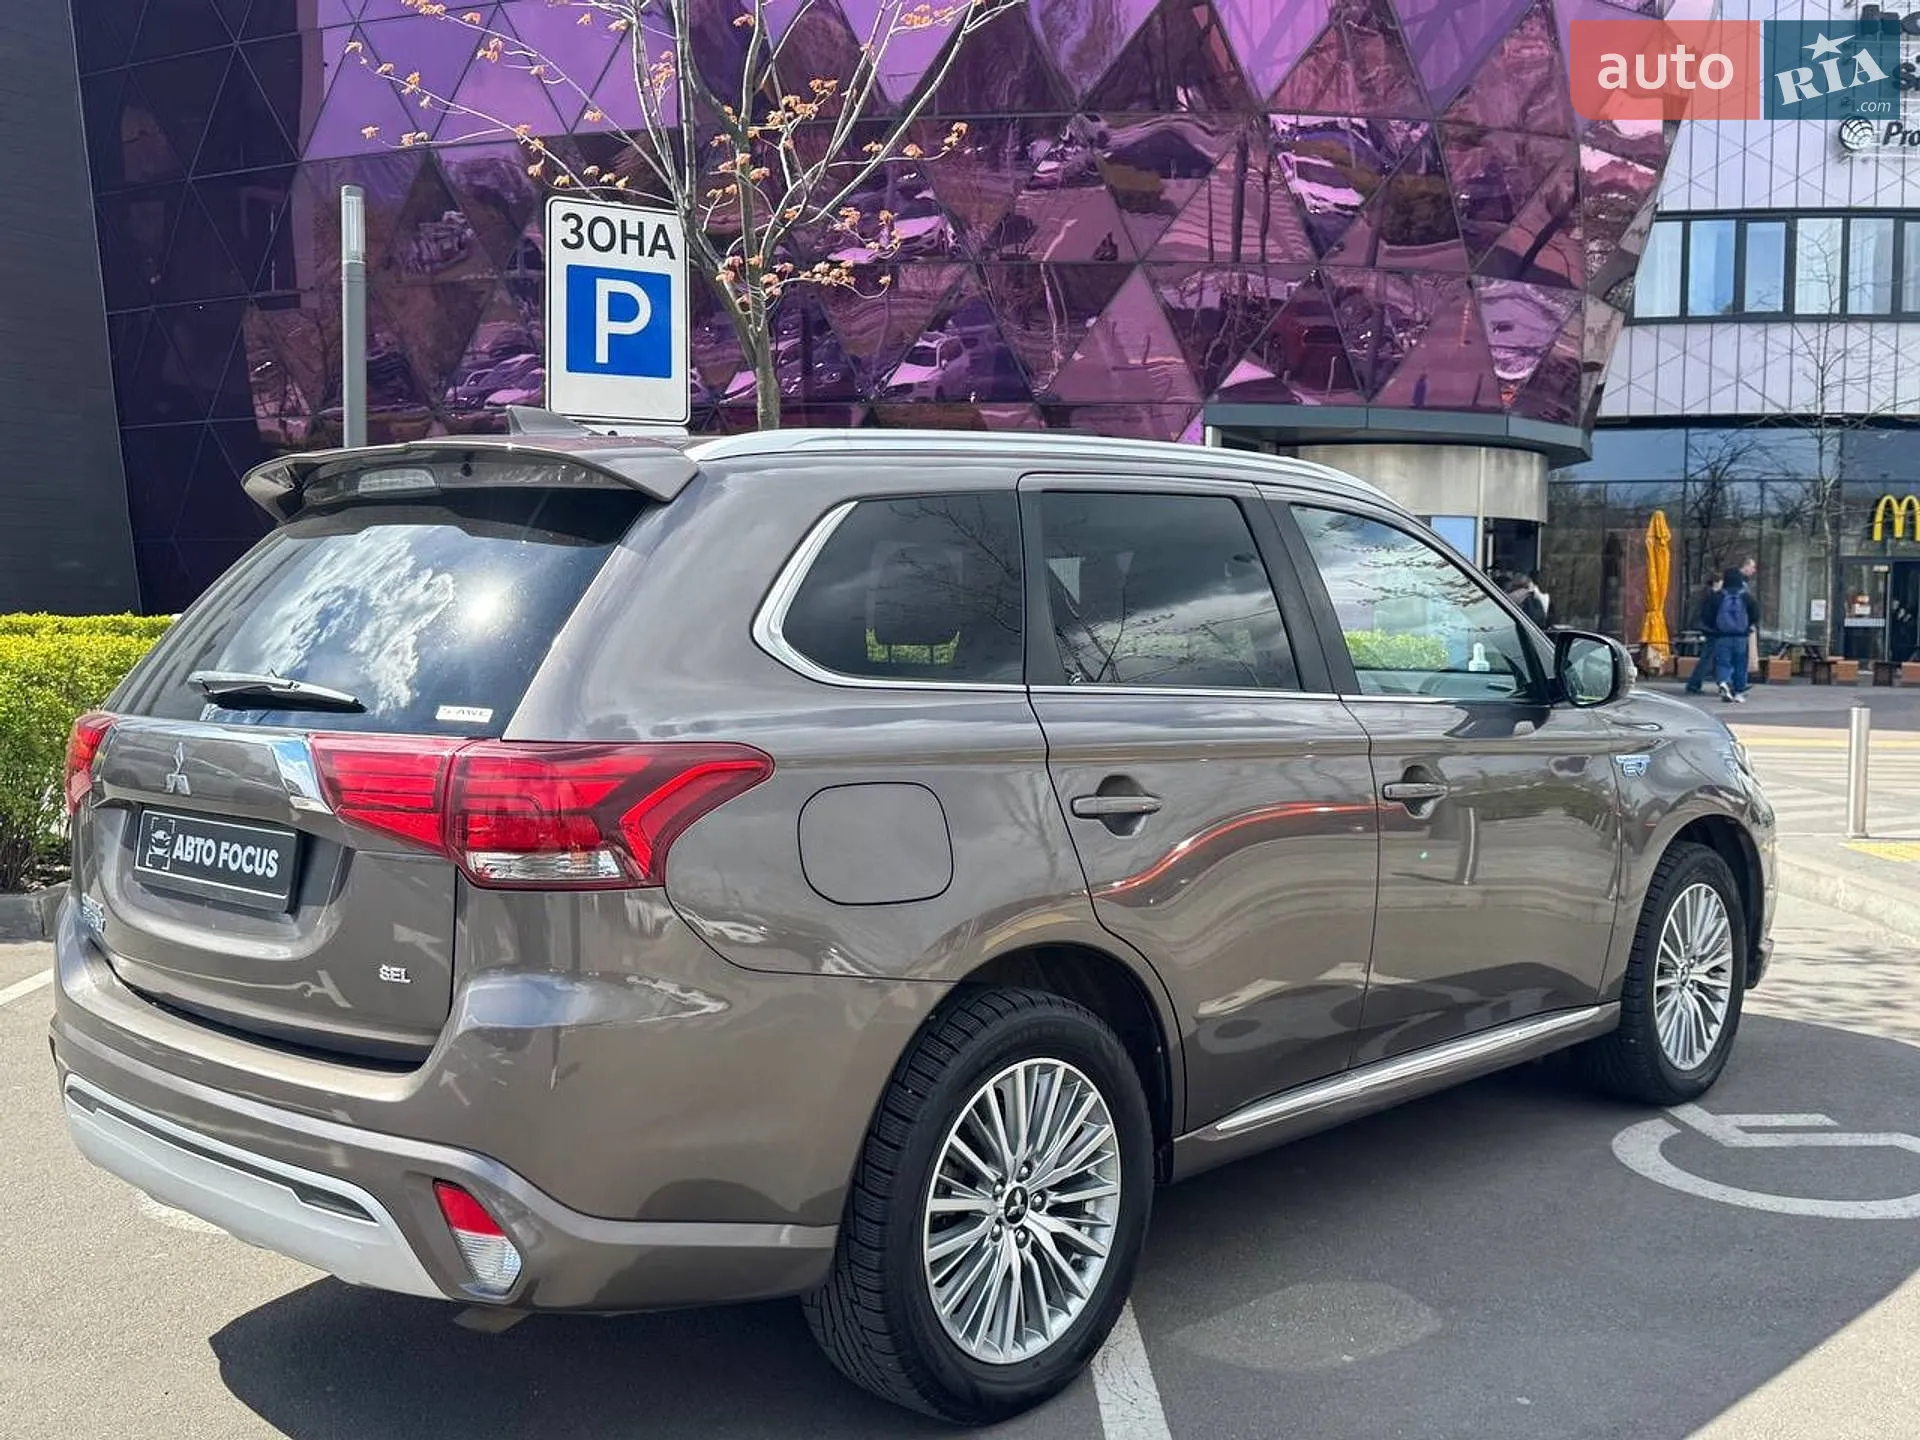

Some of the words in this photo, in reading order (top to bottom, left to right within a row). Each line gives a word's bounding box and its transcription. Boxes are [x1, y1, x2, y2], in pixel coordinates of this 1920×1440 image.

[560, 212, 676, 260] ЗОНА
[595, 278, 652, 364] P
[218, 841, 279, 878] FOCUS
[379, 964, 411, 983] SEL
